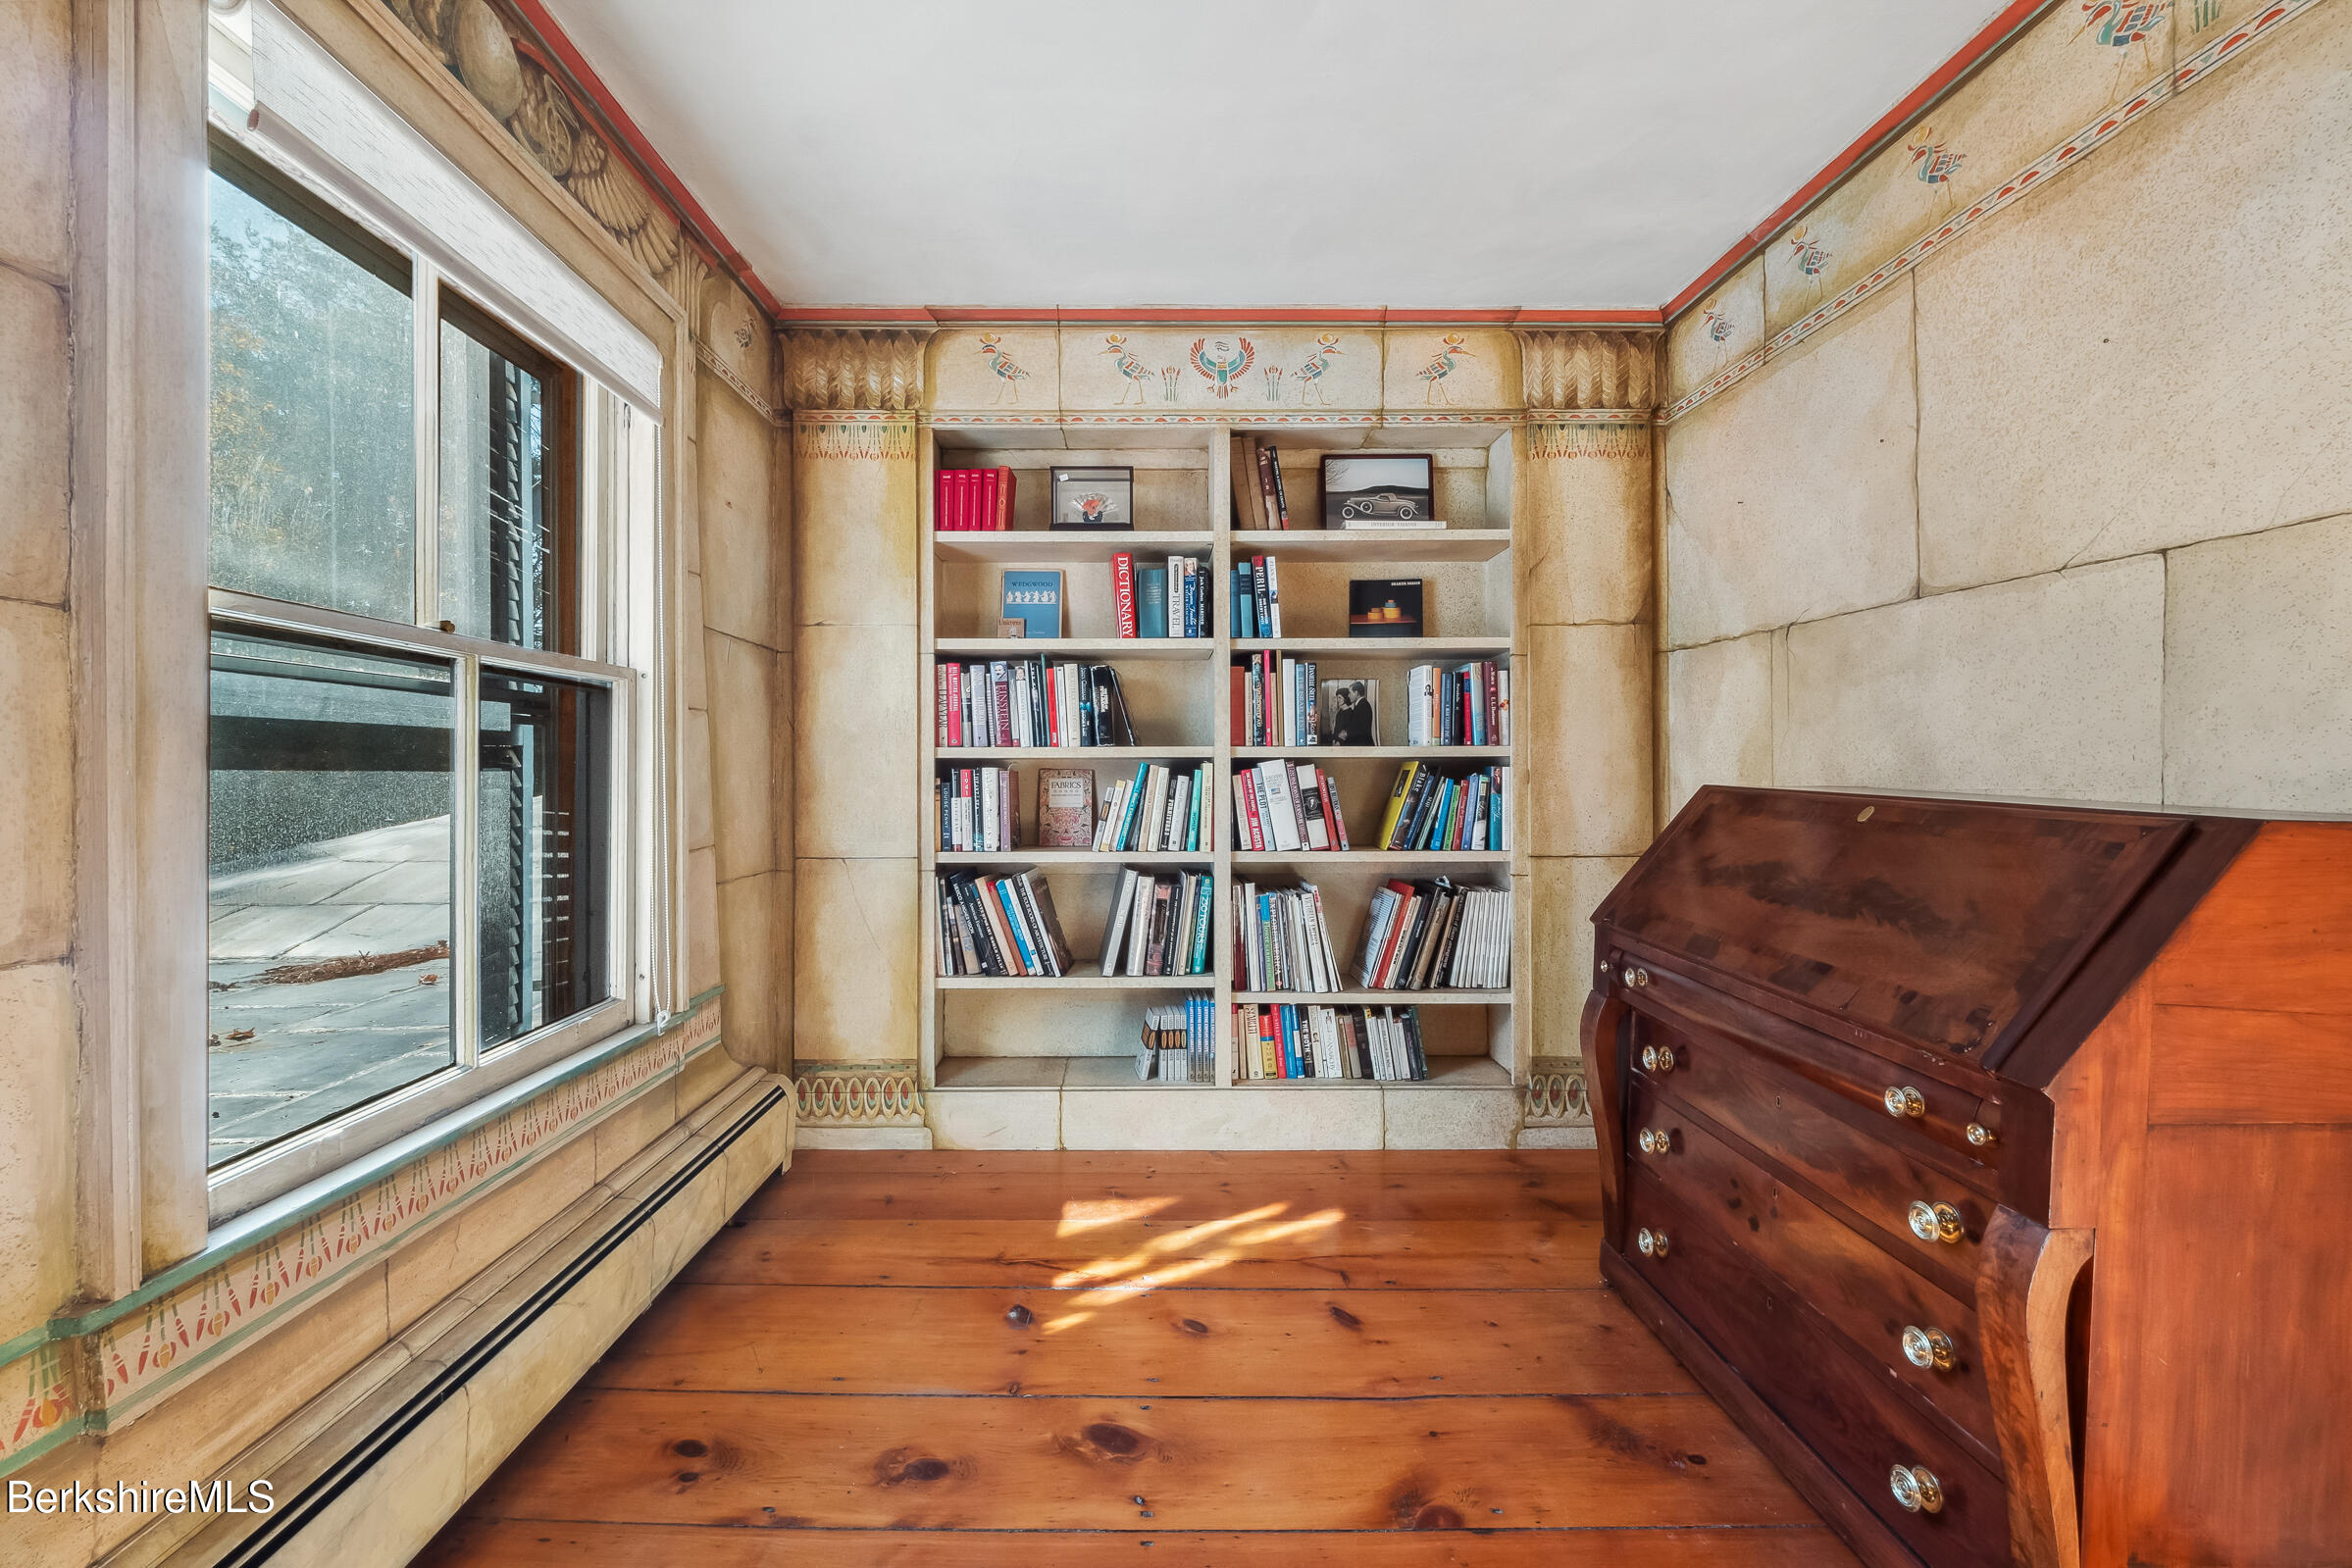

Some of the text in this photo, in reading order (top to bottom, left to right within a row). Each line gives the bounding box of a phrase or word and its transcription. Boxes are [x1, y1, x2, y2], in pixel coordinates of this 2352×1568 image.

[1255, 566, 1265, 594] PERIL
[1117, 557, 1133, 636] DICTIONARY
[1172, 593, 1181, 628] TRAVEL
[998, 684, 1009, 731] EINSTEIN
[1414, 773, 1426, 792] Blake
[1257, 794, 1266, 810] PLOT
[1252, 828, 1261, 849] ACOSTA
[1197, 913, 1208, 943] TOURS
[1303, 1034, 1311, 1053] MOTH
